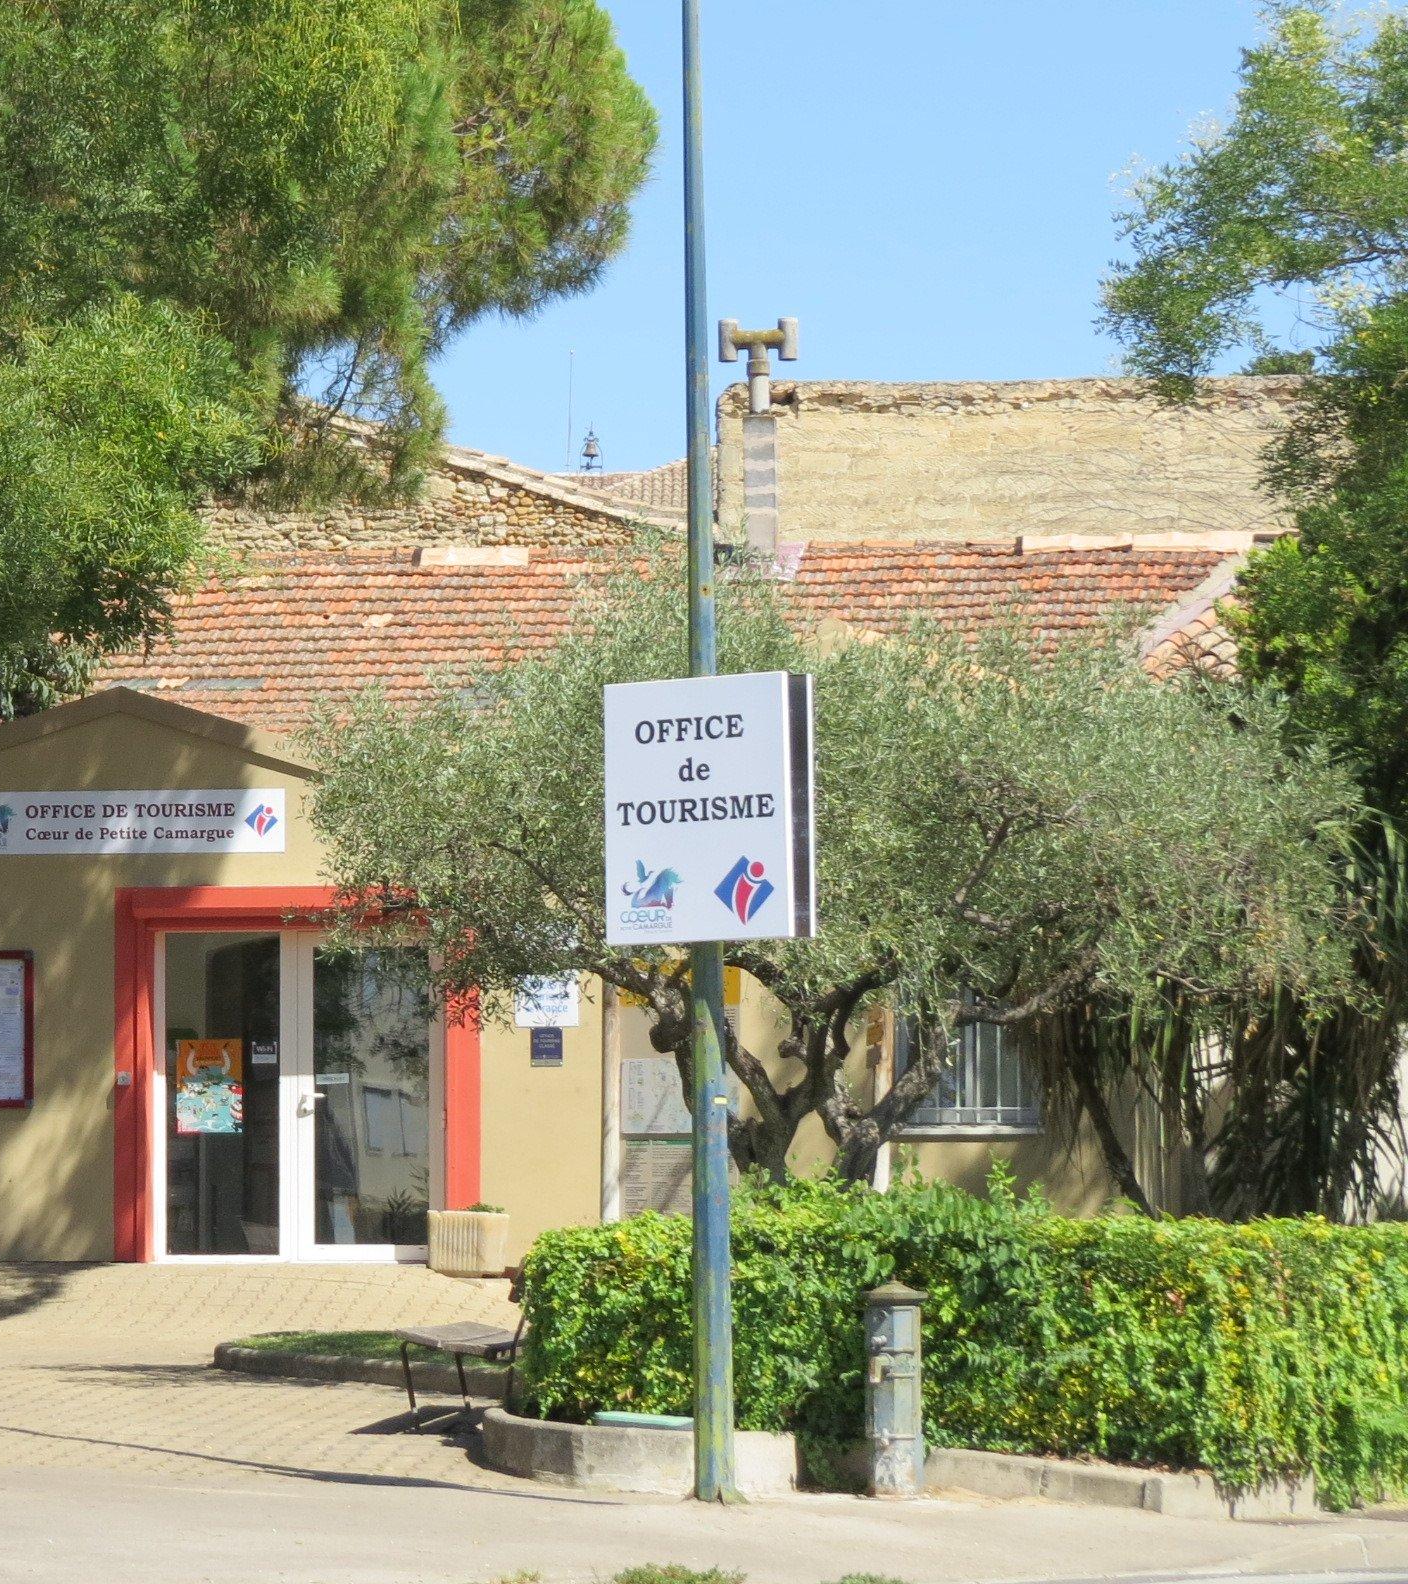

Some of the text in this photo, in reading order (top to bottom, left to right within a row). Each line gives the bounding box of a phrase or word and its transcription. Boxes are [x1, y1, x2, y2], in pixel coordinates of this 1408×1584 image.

[635, 713, 744, 745] OFFICE
[678, 757, 711, 782] de
[25, 802, 236, 819] OFFICE DE TOURISME
[616, 793, 775, 826] TOURISME
[25, 826, 235, 843] Cœur de Petite Camargue
